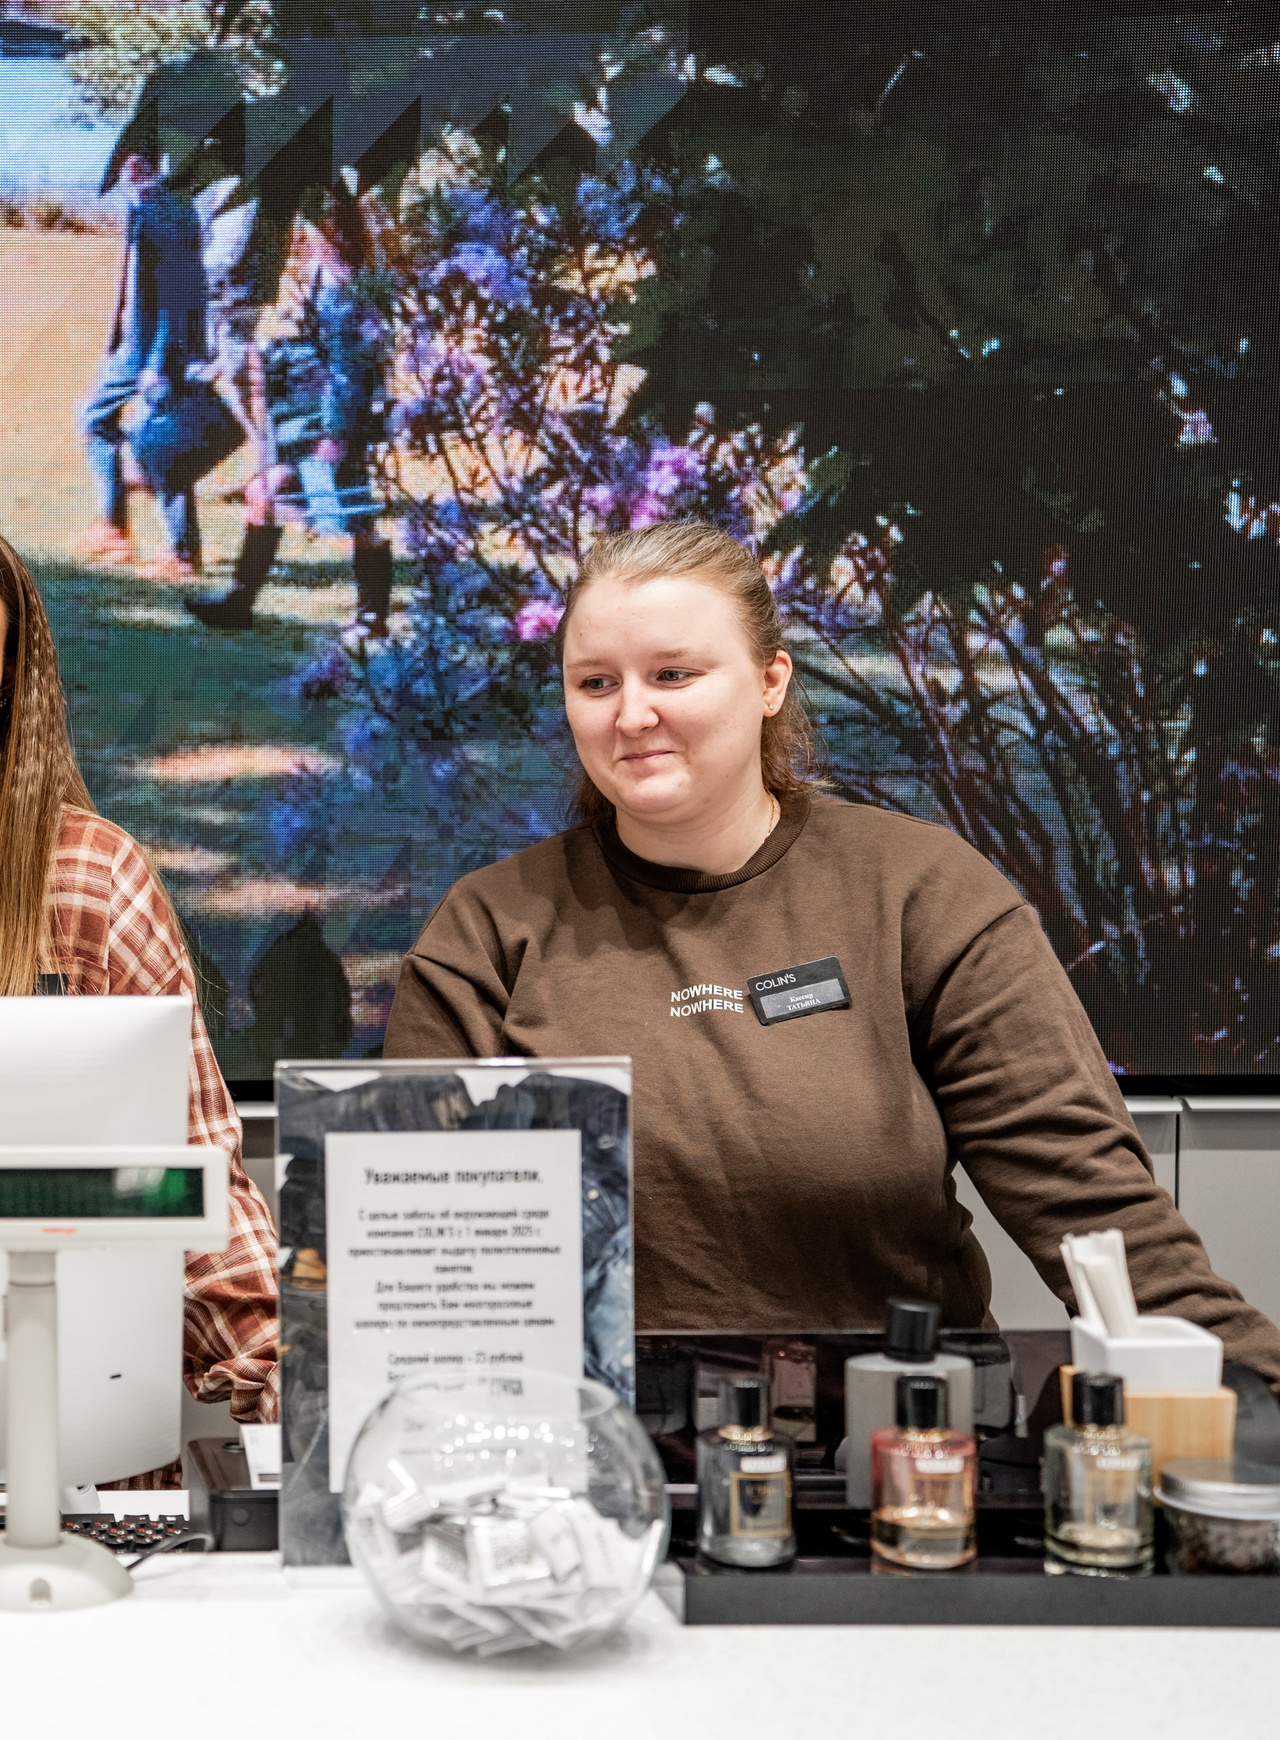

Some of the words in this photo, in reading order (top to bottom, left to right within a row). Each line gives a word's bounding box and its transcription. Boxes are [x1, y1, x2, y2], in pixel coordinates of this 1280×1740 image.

[755, 973, 797, 992] COLIN'S
[670, 983, 743, 1002] NOWHERE
[789, 993, 814, 1003] Кассир
[670, 999, 744, 1018] NOWHERE
[786, 998, 822, 1011] ТАТЬЯНА
[364, 1168, 450, 1186] Уважаемые
